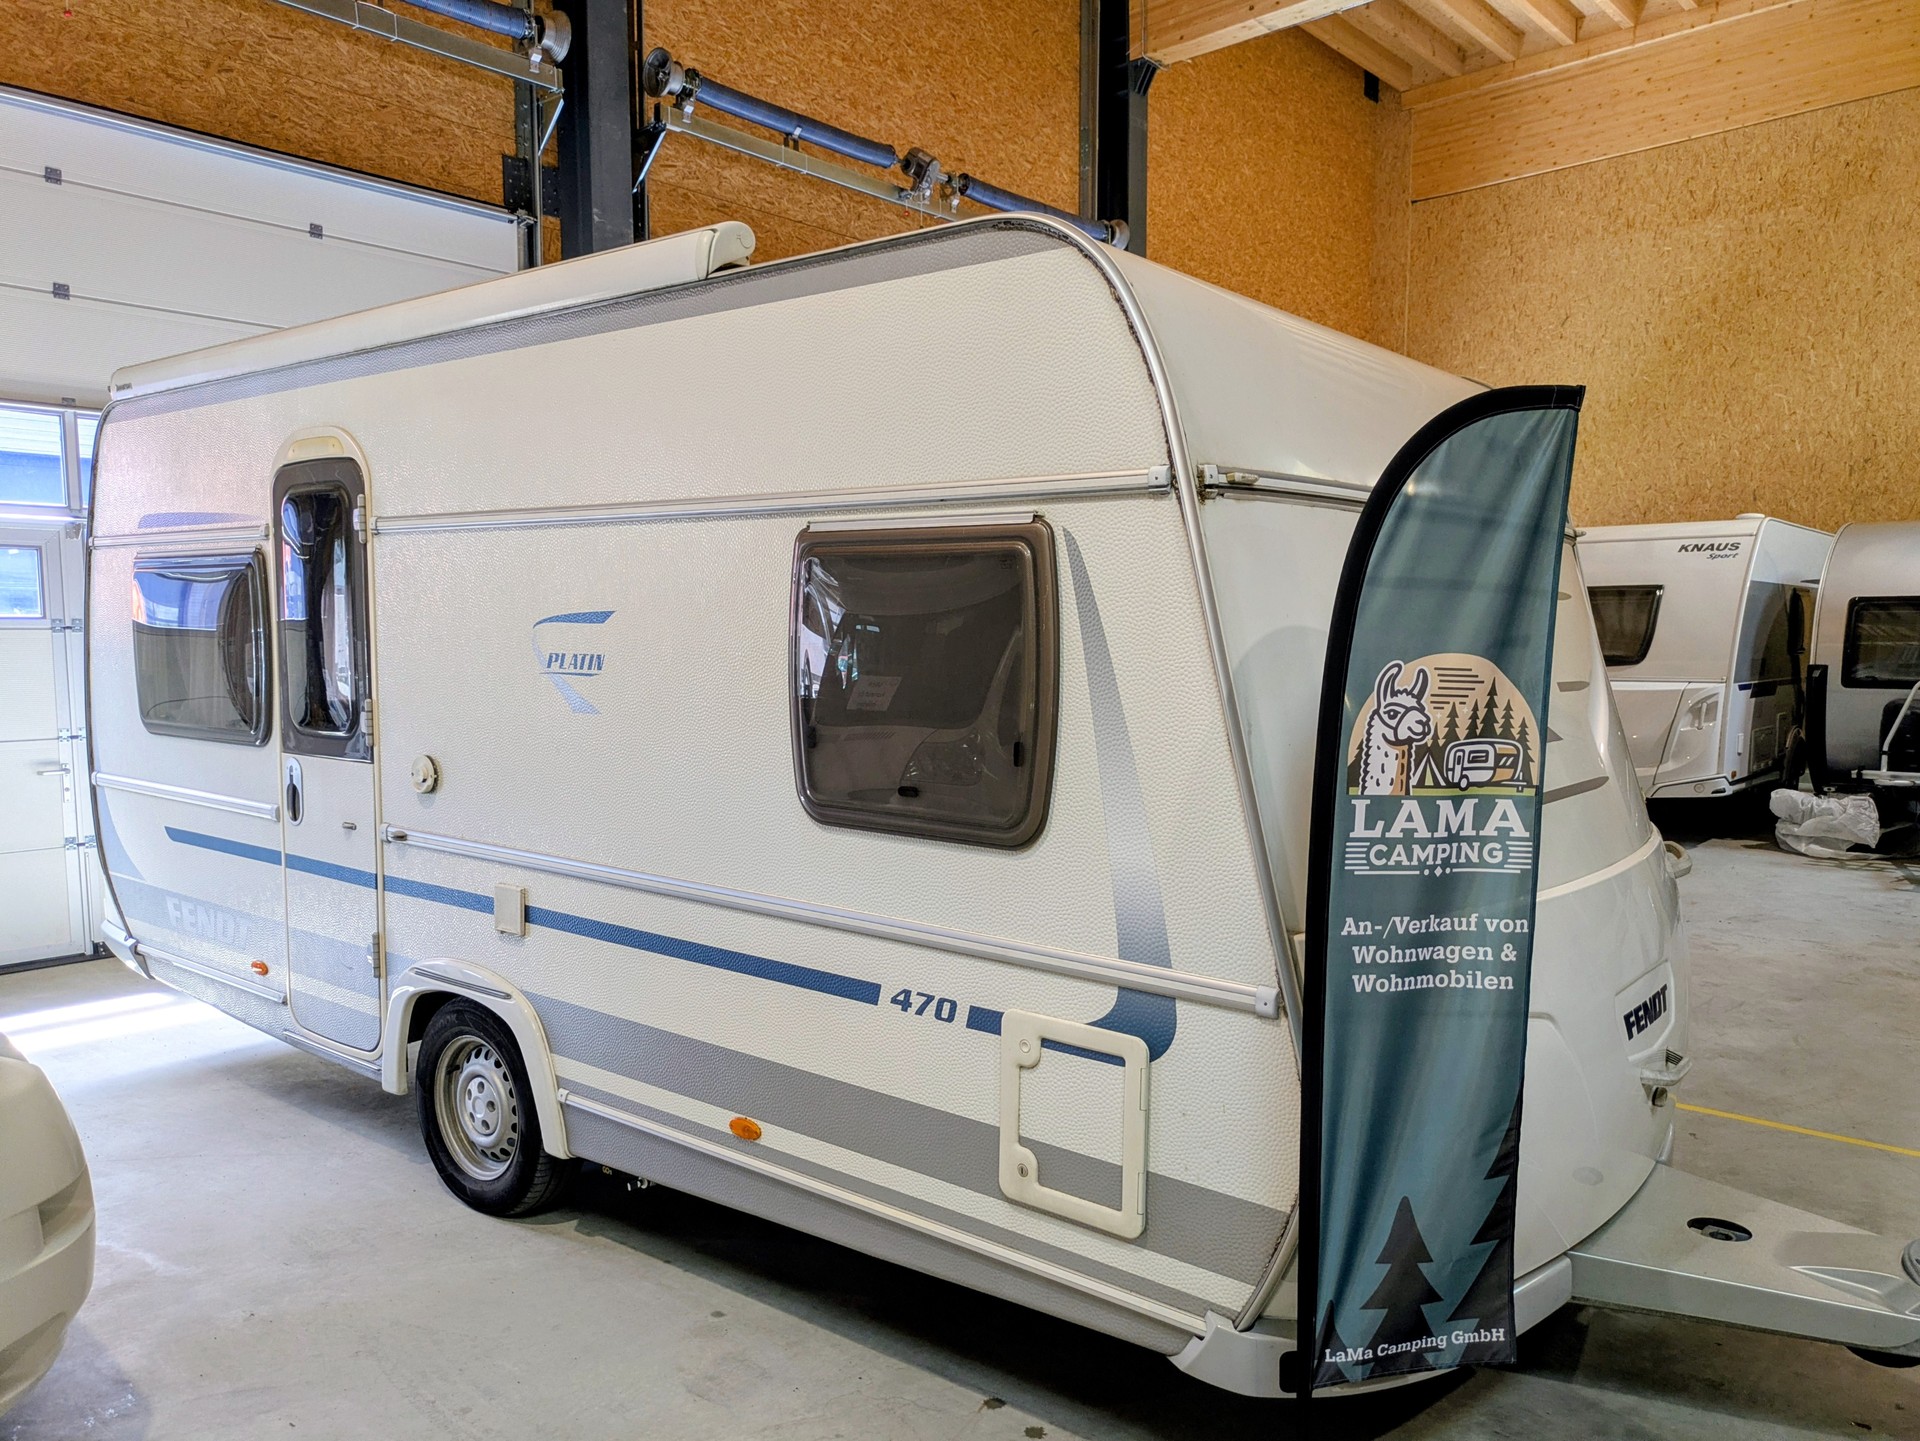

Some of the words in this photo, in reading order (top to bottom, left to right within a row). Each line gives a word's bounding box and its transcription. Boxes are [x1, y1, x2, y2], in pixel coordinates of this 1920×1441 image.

[1677, 542, 1741, 553] KNAUS
[1706, 552, 1739, 561] Sport
[546, 652, 606, 671] PLATIN
[1349, 798, 1530, 838] LAMA
[1369, 841, 1504, 867] CAMPING
[1484, 917, 1529, 933] von
[1352, 944, 1494, 964] Wohnwagen
[1500, 943, 1517, 962] &
[1352, 970, 1514, 993] Wohnmobilen
[890, 988, 958, 1024] 470
[1623, 983, 1668, 1041] FENDT
[1325, 1347, 1373, 1363] LaMa
[1377, 1335, 1448, 1357] Camping
[1451, 1328, 1505, 1345] GmbH
